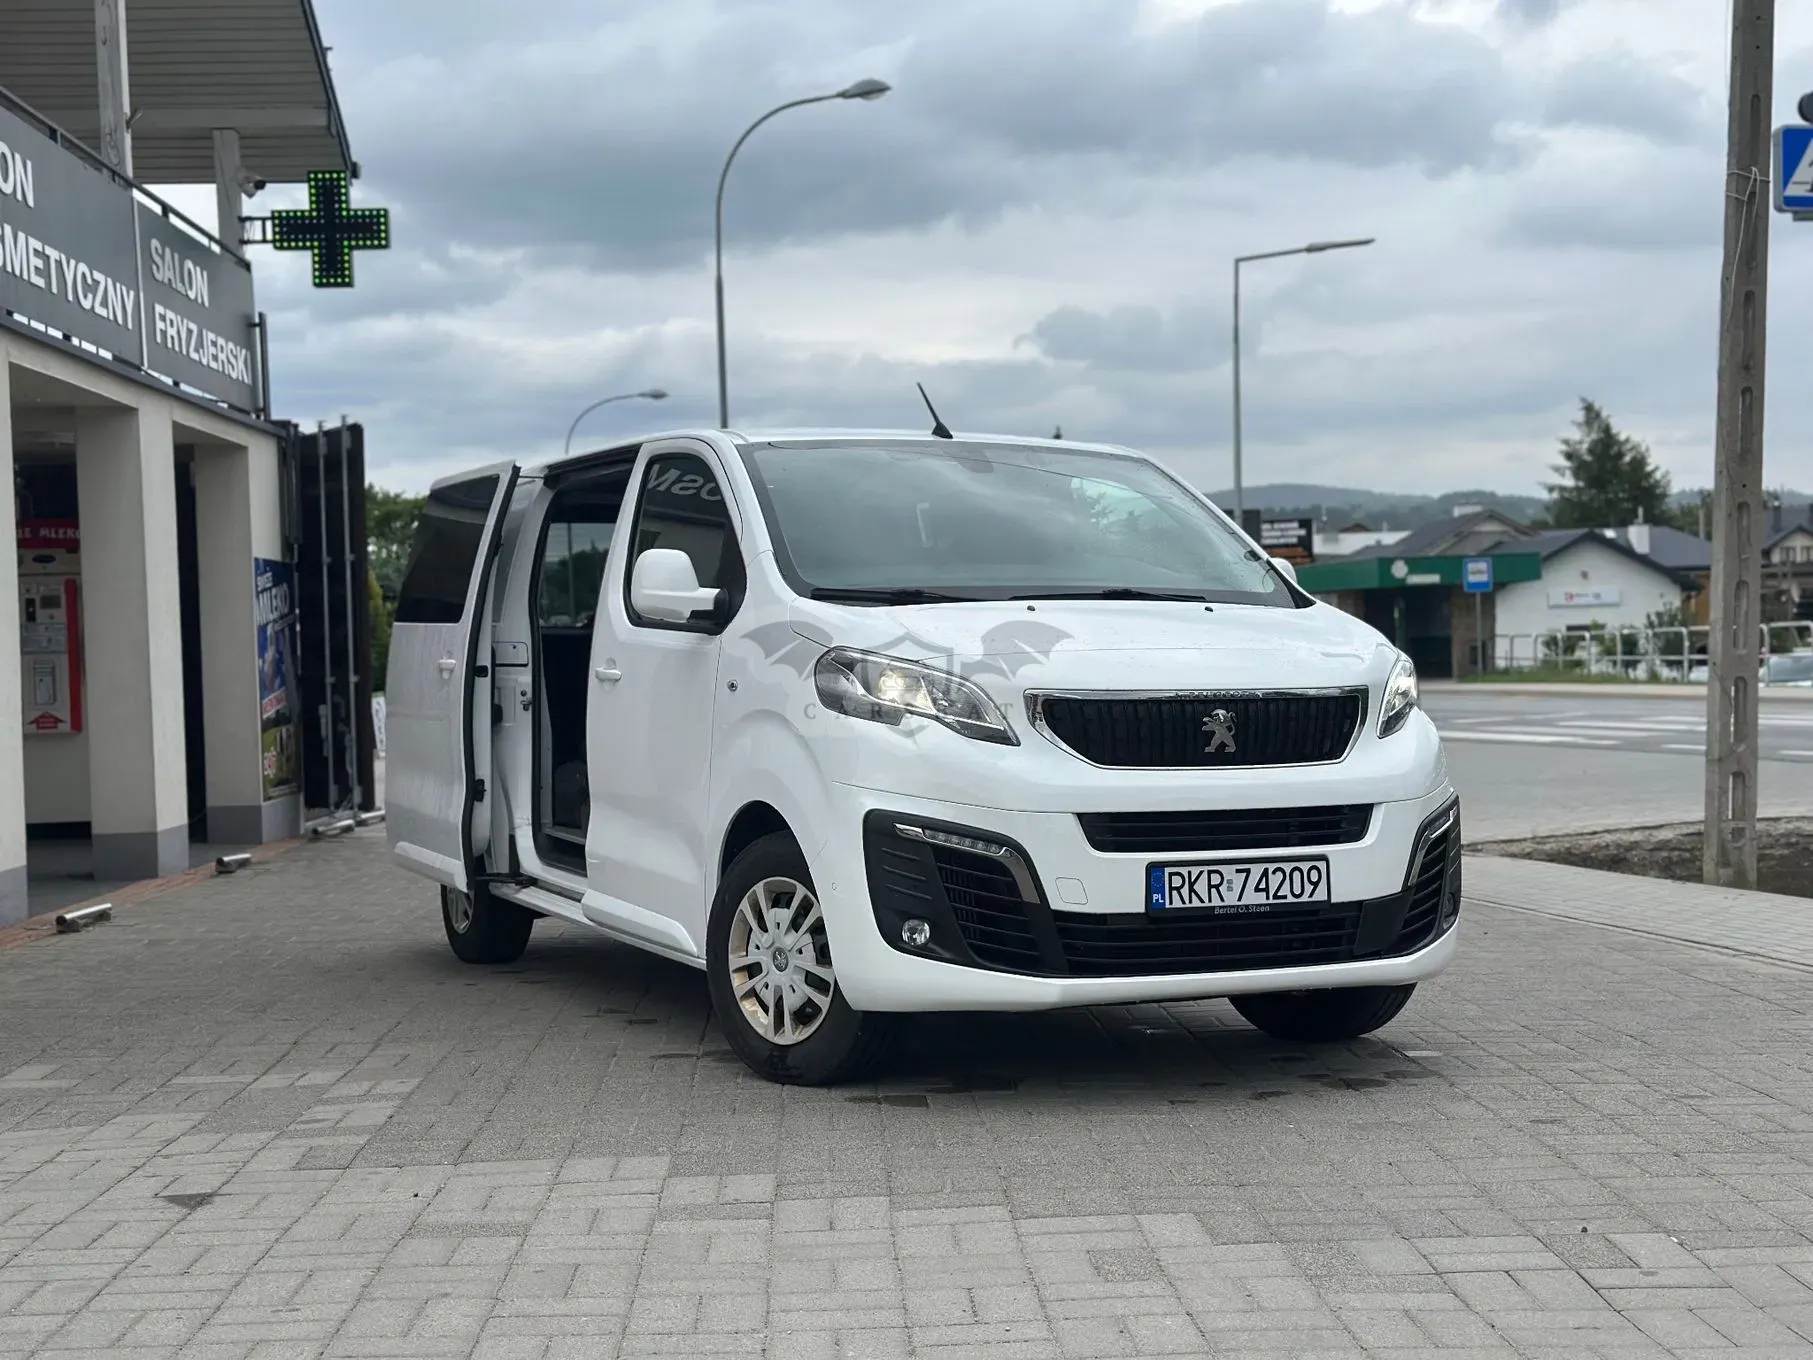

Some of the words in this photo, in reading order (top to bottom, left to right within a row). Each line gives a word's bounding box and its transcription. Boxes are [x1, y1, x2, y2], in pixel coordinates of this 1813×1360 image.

[0, 223, 134, 331] METYCZNY
[151, 237, 209, 308] SALON
[154, 302, 252, 386] FRYZJERSKI
[1152, 893, 1164, 903] PL
[1168, 869, 1225, 905] RKR
[1235, 864, 1322, 902] 74209
